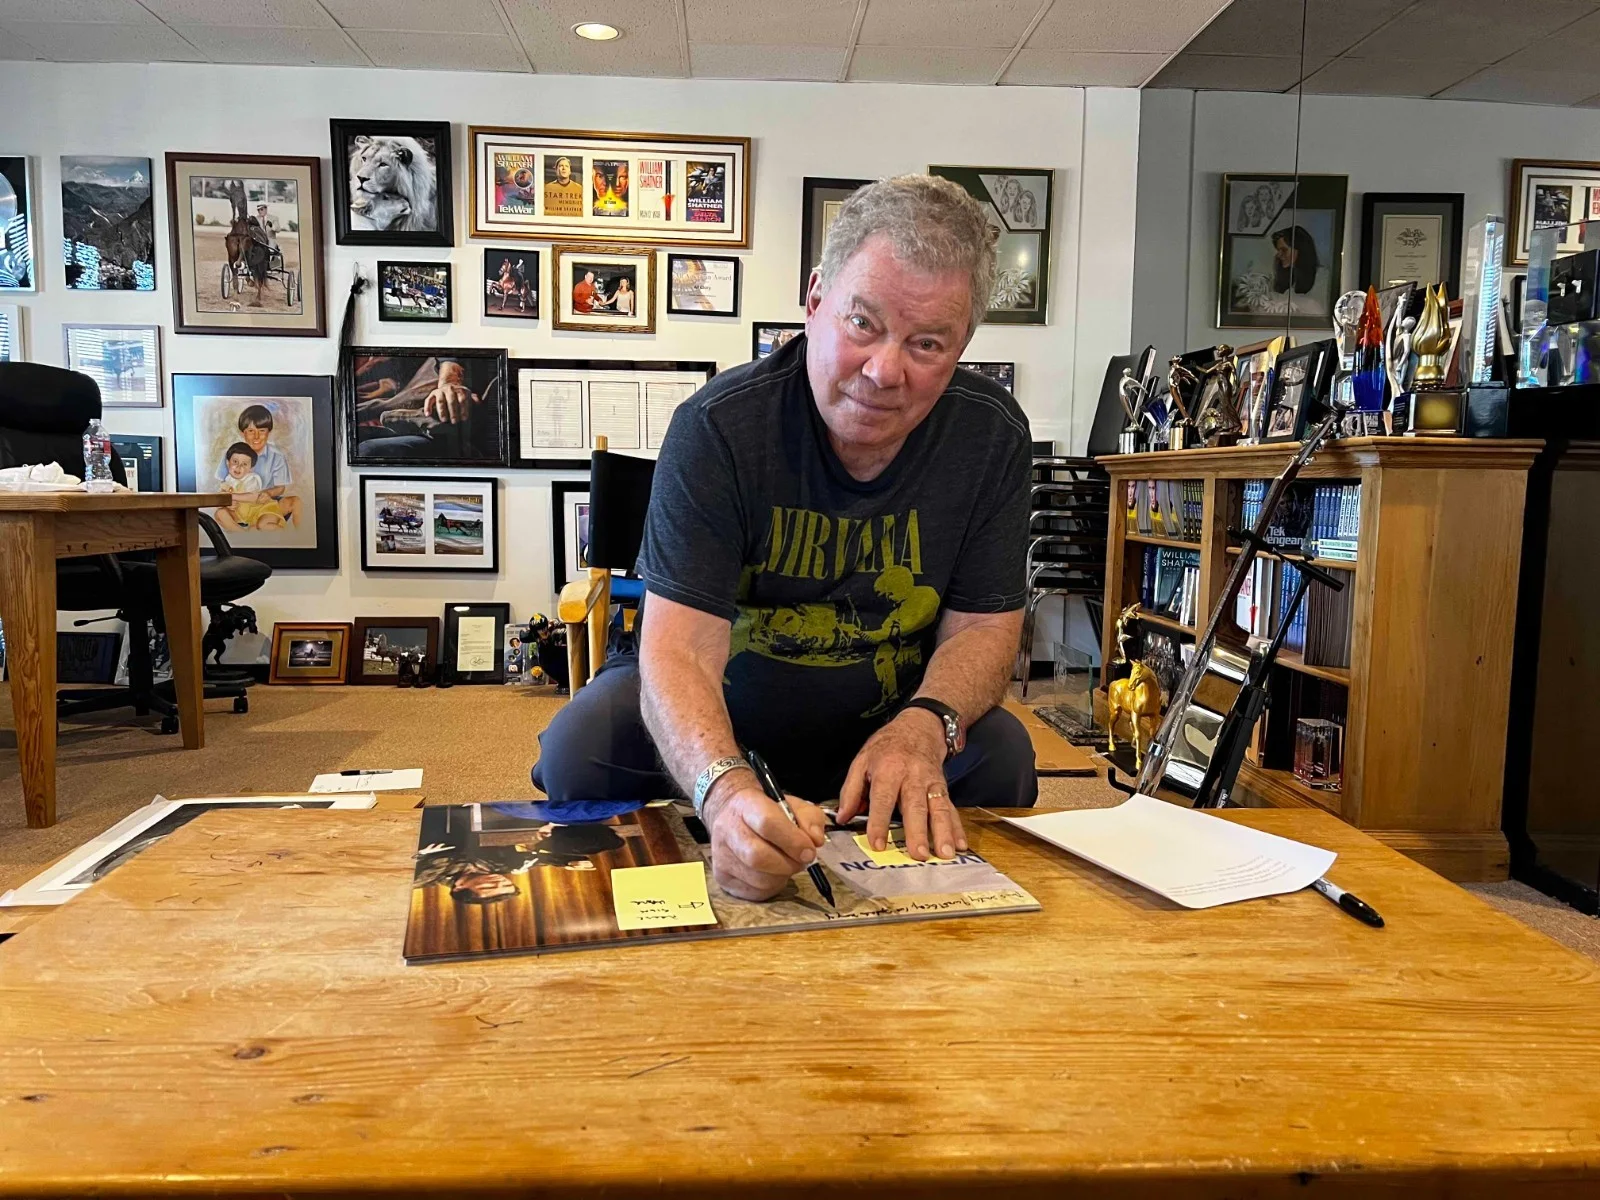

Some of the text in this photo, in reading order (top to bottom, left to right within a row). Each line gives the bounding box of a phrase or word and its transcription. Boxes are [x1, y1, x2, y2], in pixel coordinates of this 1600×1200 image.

[496, 154, 533, 163] WILLIAM
[639, 161, 663, 175] WILLIAM
[639, 175, 663, 189] SHATNER
[565, 192, 582, 200] TREK
[498, 204, 534, 214] TekWar
[1269, 526, 1286, 537] Tek
[765, 506, 924, 580] NIRVANA
[1262, 533, 1308, 547] engean
[1162, 551, 1198, 559] WILLIA
[1161, 559, 1199, 567] SHATN
